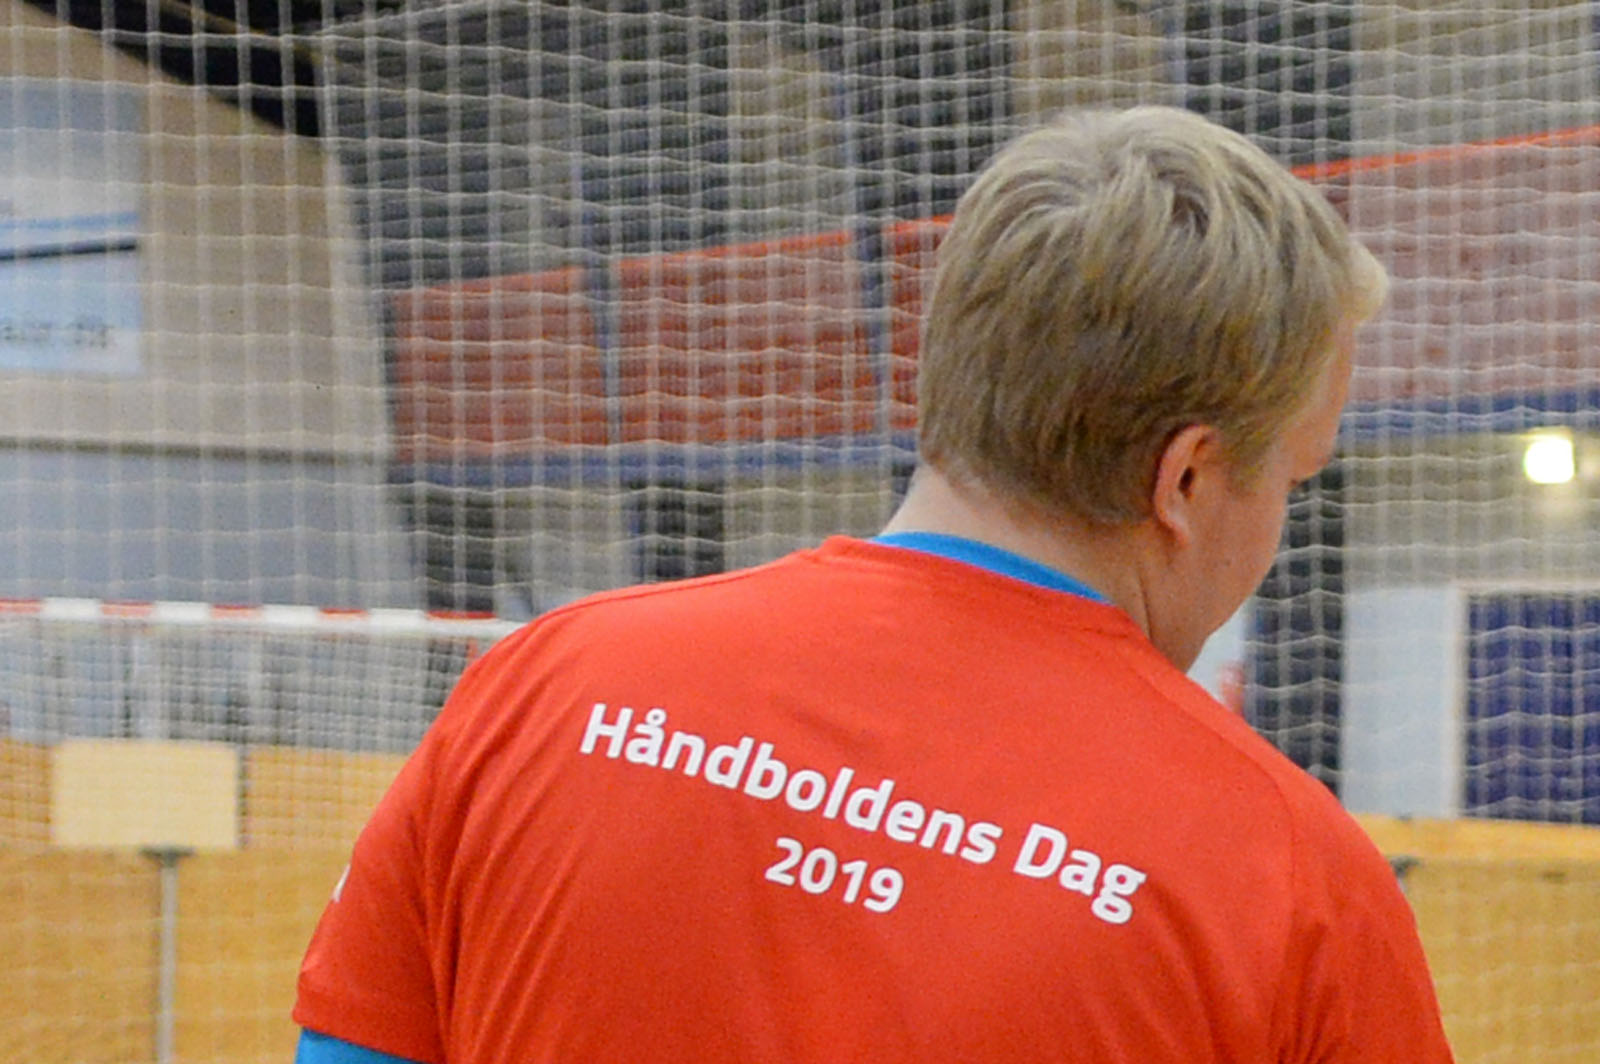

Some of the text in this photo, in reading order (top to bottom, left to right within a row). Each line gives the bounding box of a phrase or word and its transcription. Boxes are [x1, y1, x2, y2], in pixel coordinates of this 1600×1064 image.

[580, 703, 1147, 924] Håndboldens Dag
[765, 837, 904, 913] 2019
